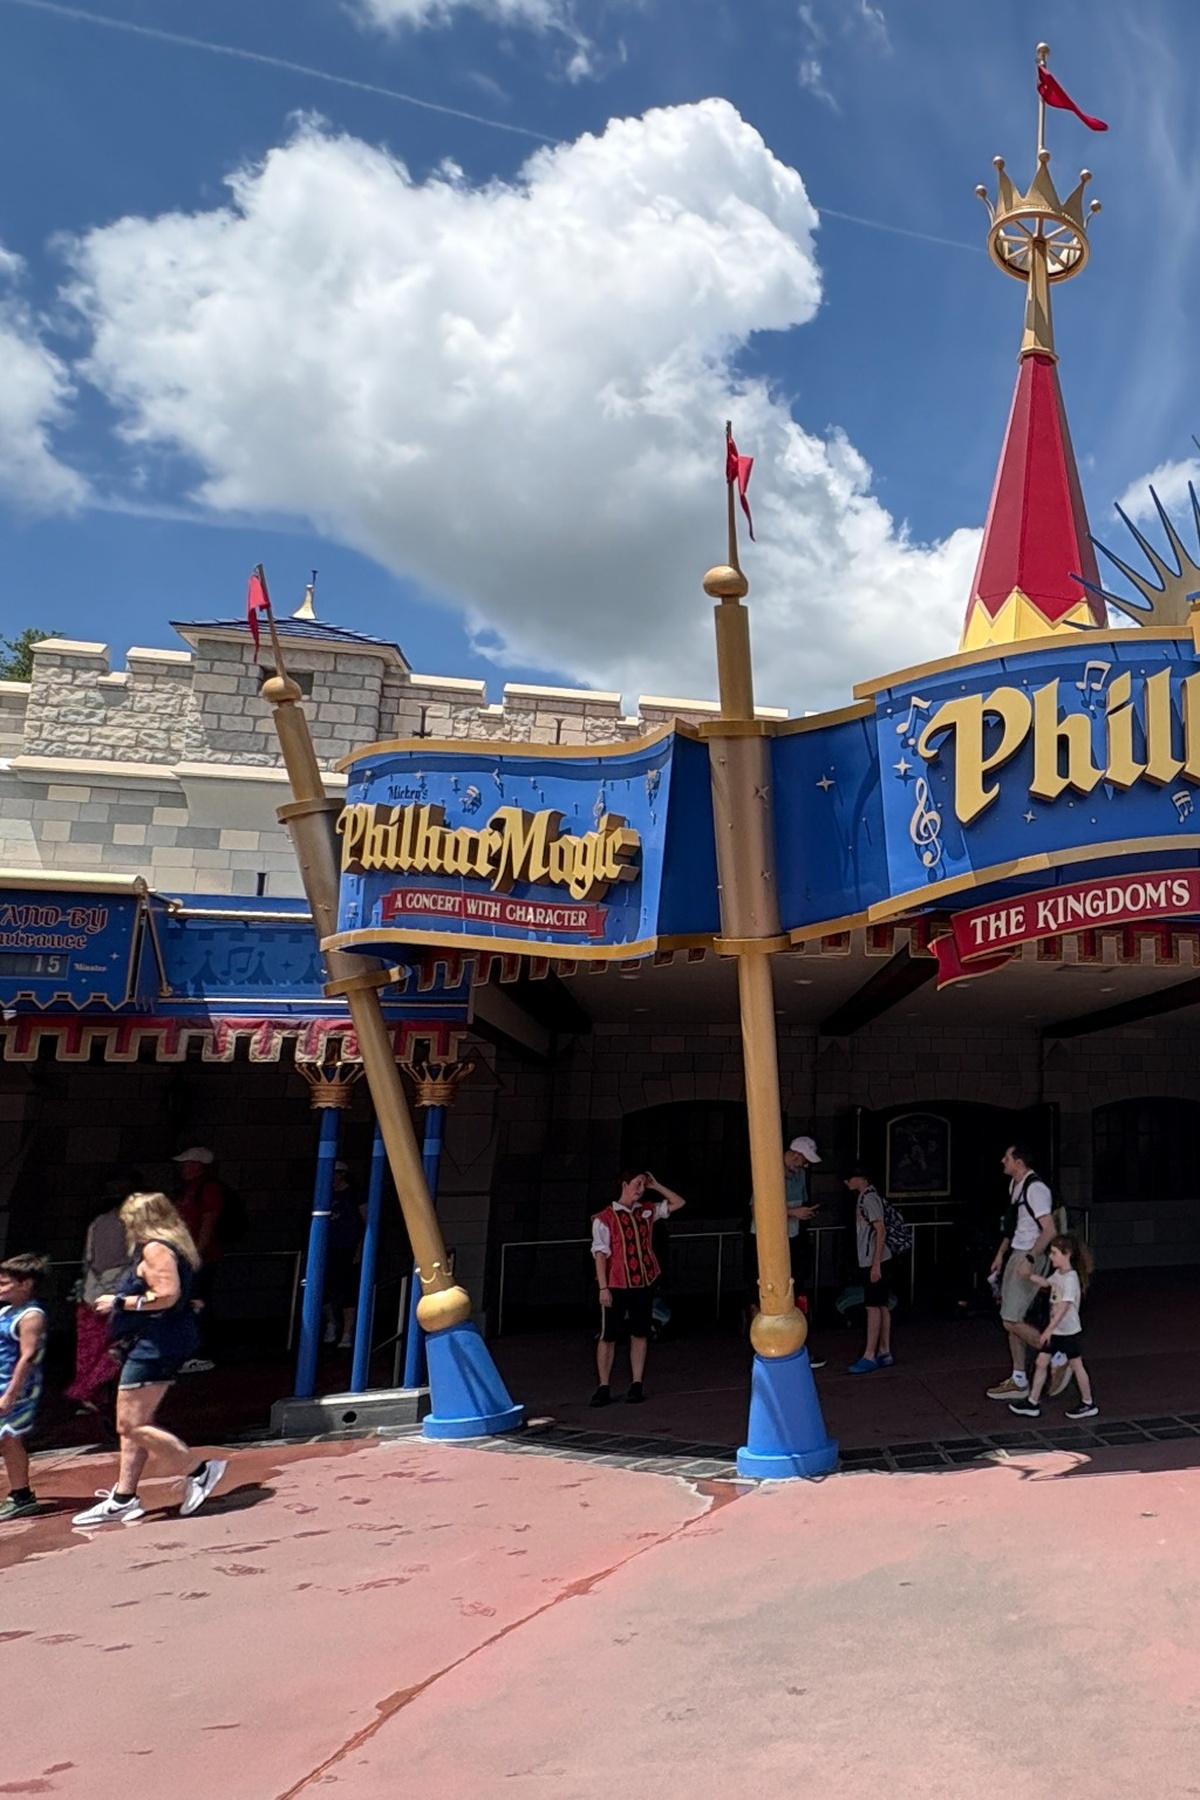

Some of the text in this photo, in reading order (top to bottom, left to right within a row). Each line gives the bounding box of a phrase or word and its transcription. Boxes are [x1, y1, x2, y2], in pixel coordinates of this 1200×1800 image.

[388, 785, 428, 801] Mickey's
[336, 803, 630, 900] PhilharMagic
[395, 893, 587, 926] A CONCERT WITH CHARACTER
[970, 906, 1026, 945] THE
[1037, 878, 1190, 931] KINGDOM'S
[35, 955, 60, 973] 15
